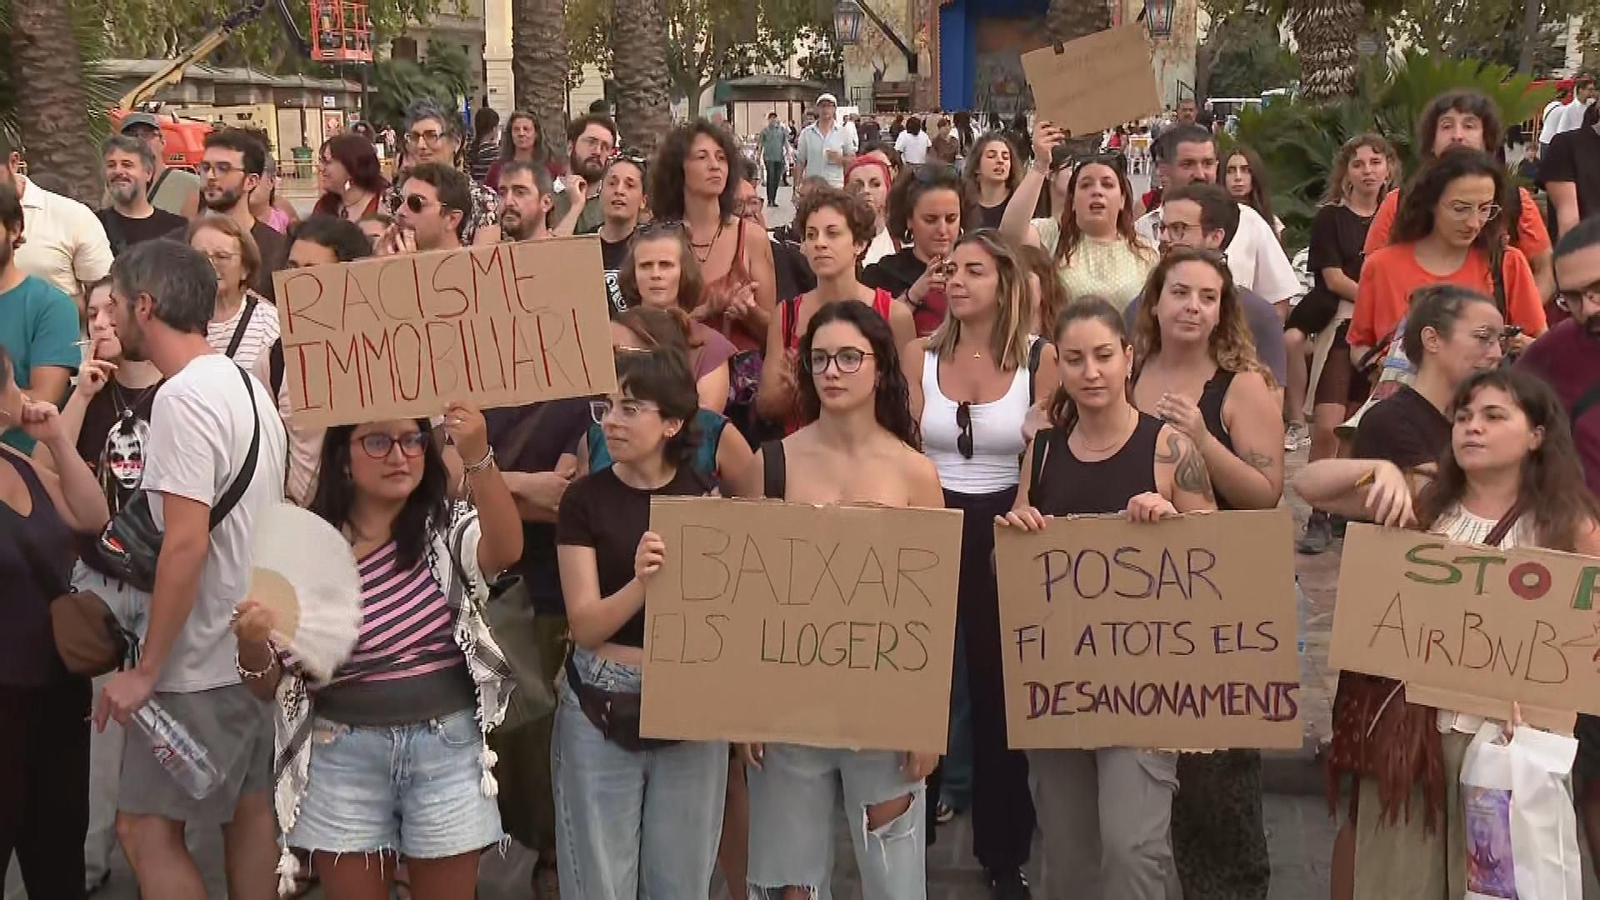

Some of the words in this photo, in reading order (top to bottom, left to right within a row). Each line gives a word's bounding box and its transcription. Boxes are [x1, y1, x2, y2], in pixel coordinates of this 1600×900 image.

[283, 245, 549, 335] RACISME
[285, 307, 592, 410] IMMOBILIARI
[680, 524, 940, 608] BAIXAR
[1032, 546, 1223, 603] POSAR
[649, 612, 731, 664] ELS
[760, 617, 931, 672] LLOGERS
[1209, 620, 1280, 655] ELS
[1022, 679, 1301, 722] DESANONAMENTS
